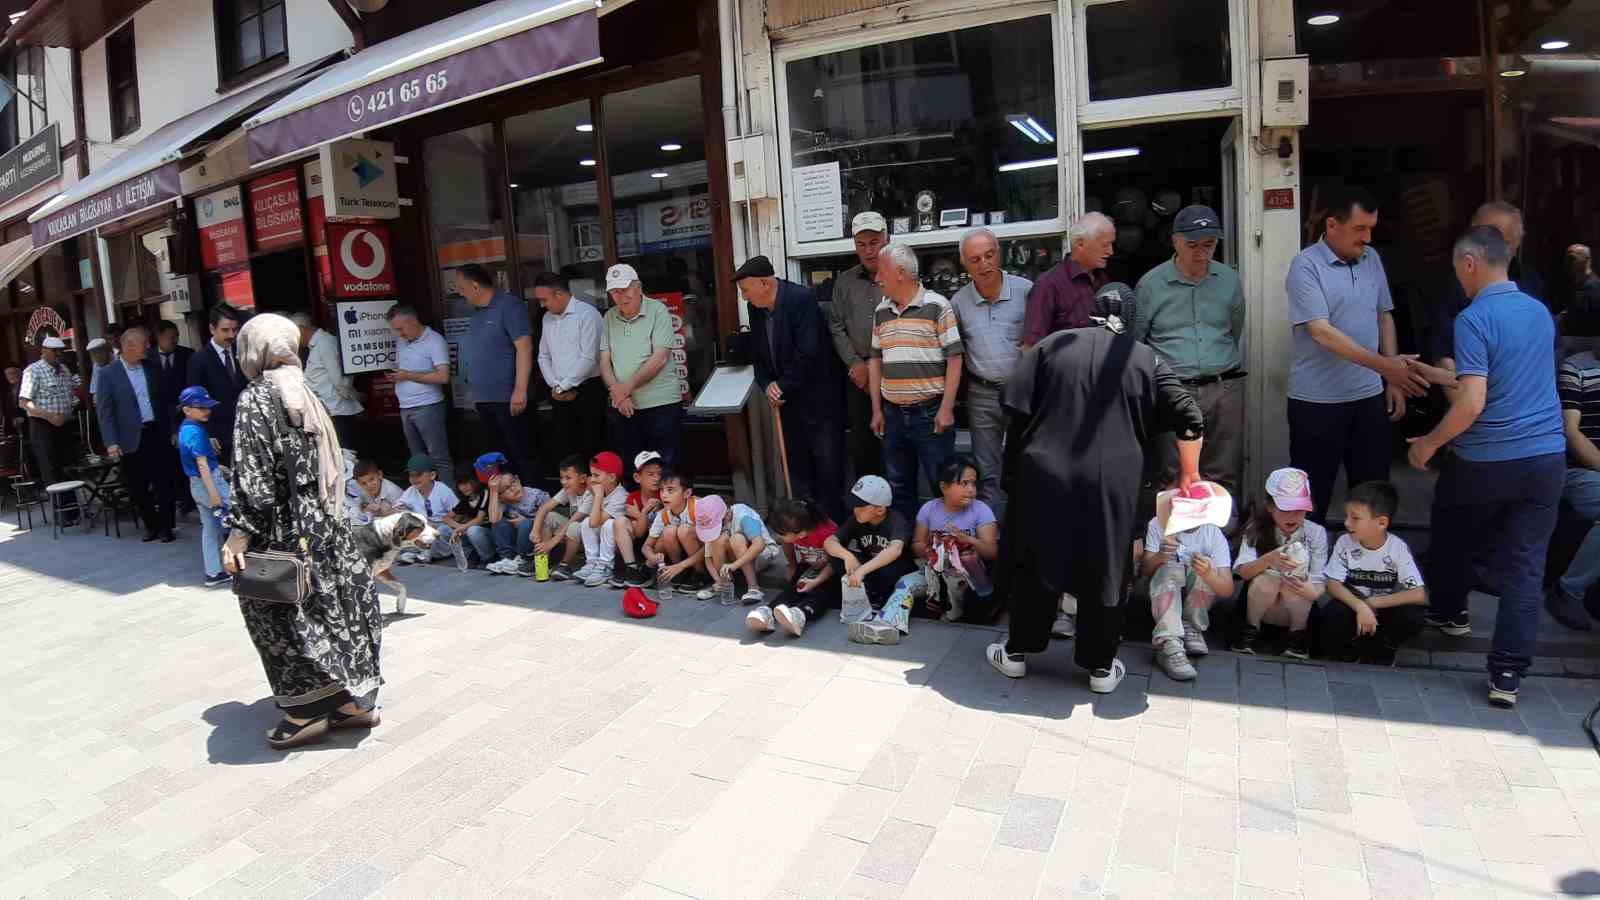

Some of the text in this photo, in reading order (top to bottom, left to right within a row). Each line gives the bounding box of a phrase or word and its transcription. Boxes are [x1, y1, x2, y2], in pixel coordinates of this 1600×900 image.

[367, 70, 448, 113] 421 65 65
[343, 280, 391, 292] vodafone
